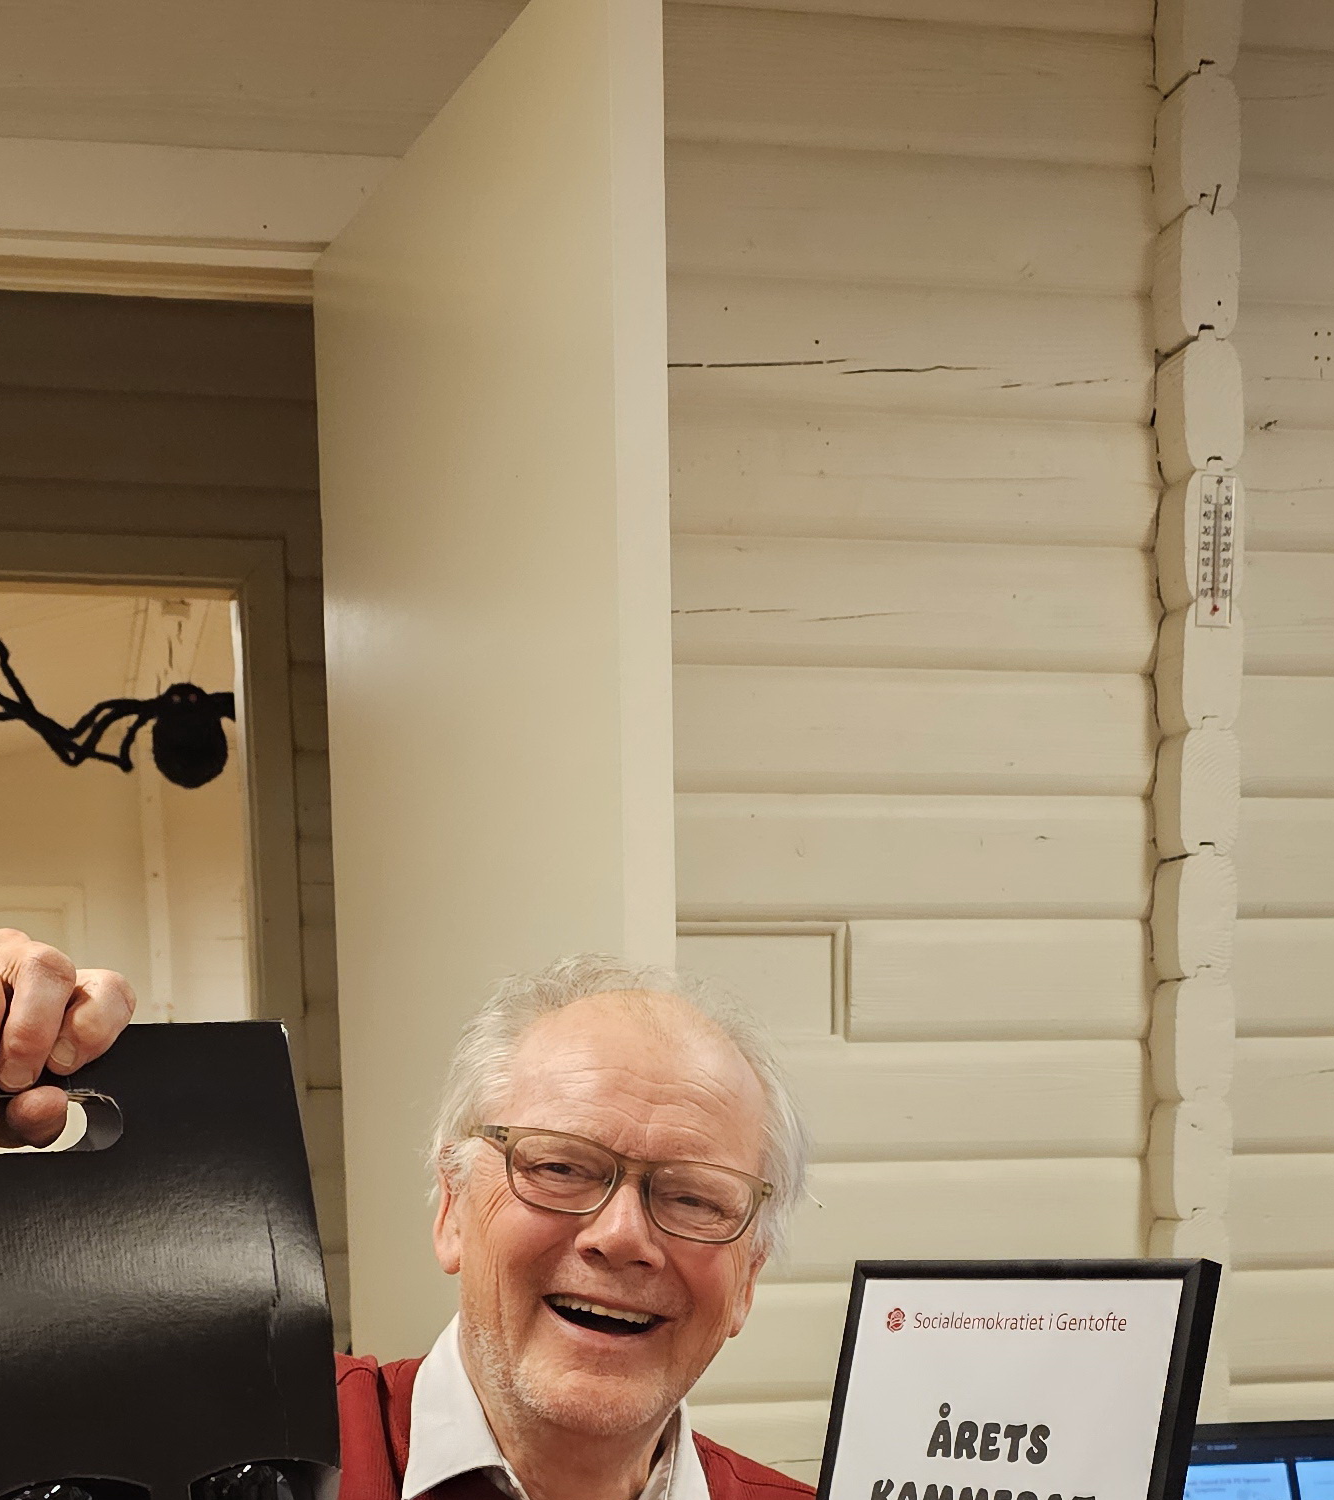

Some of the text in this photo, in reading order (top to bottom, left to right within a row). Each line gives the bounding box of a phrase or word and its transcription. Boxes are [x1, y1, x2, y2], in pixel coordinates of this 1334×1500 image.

[914, 1311, 1128, 1332] Socialdemokratiet i Gentofte
[926, 1402, 1051, 1465] ÅRETS
